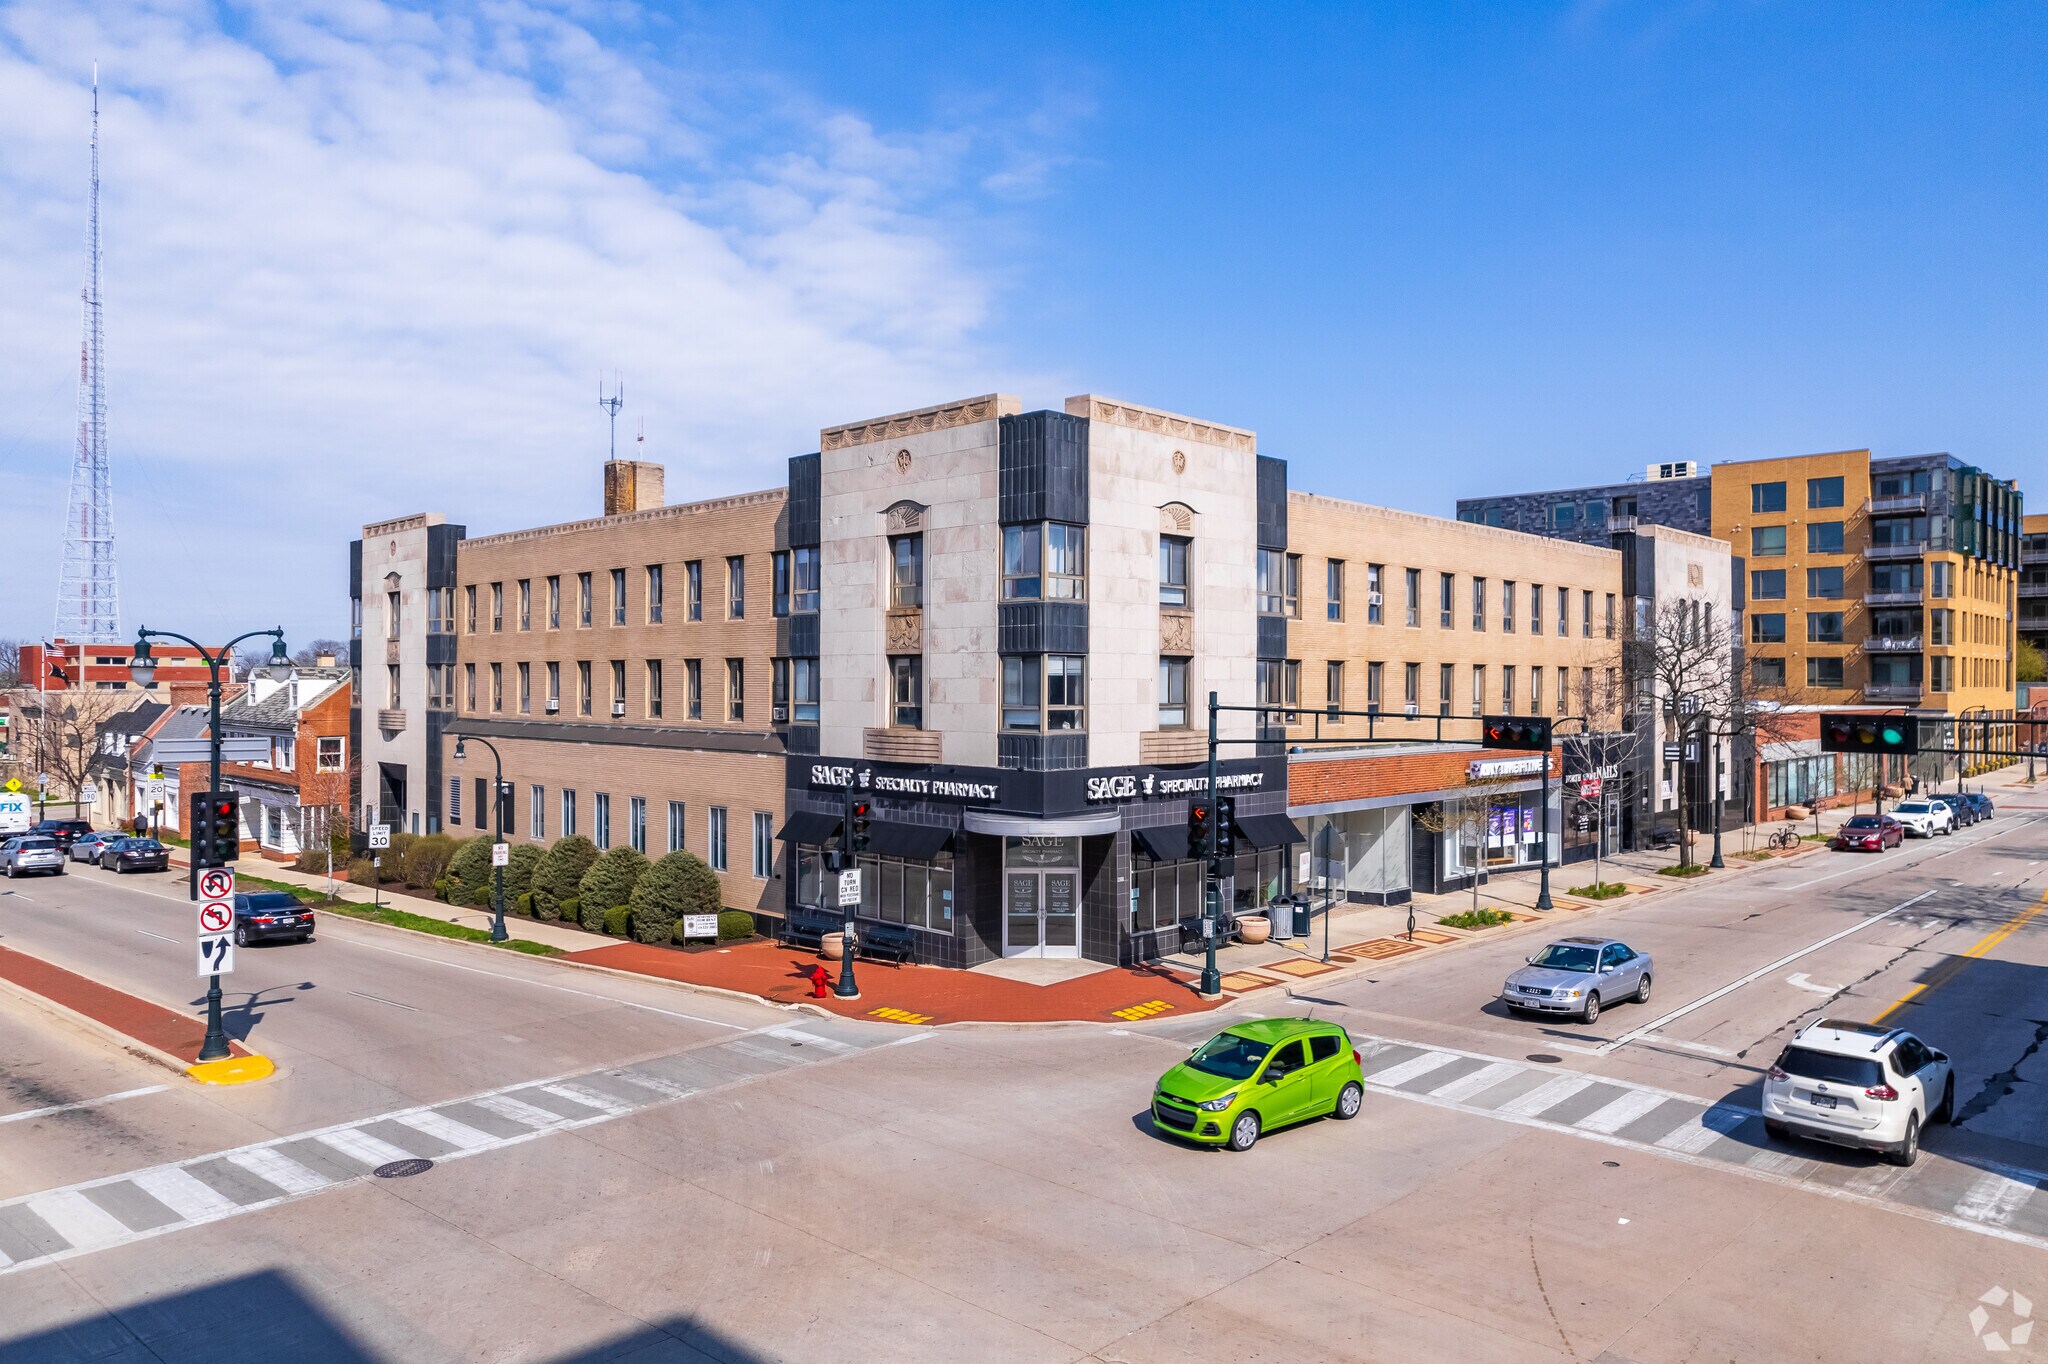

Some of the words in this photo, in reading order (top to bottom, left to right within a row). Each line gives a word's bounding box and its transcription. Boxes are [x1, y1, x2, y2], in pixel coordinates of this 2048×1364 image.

[1518, 758, 1553, 773] FITNES
[812, 765, 853, 787] SAGE
[875, 776, 931, 794] SPECIALTY
[932, 780, 999, 799] PHARMACY
[1087, 775, 1137, 799] SAGE
[1159, 776, 1210, 794] SPECIALTY
[1215, 772, 1264, 789] PHARMACY
[371, 837, 388, 846] 30
[1022, 836, 1064, 847] SAGE
[1013, 879, 1033, 887] SAGE
[1051, 879, 1071, 887] SAGE
